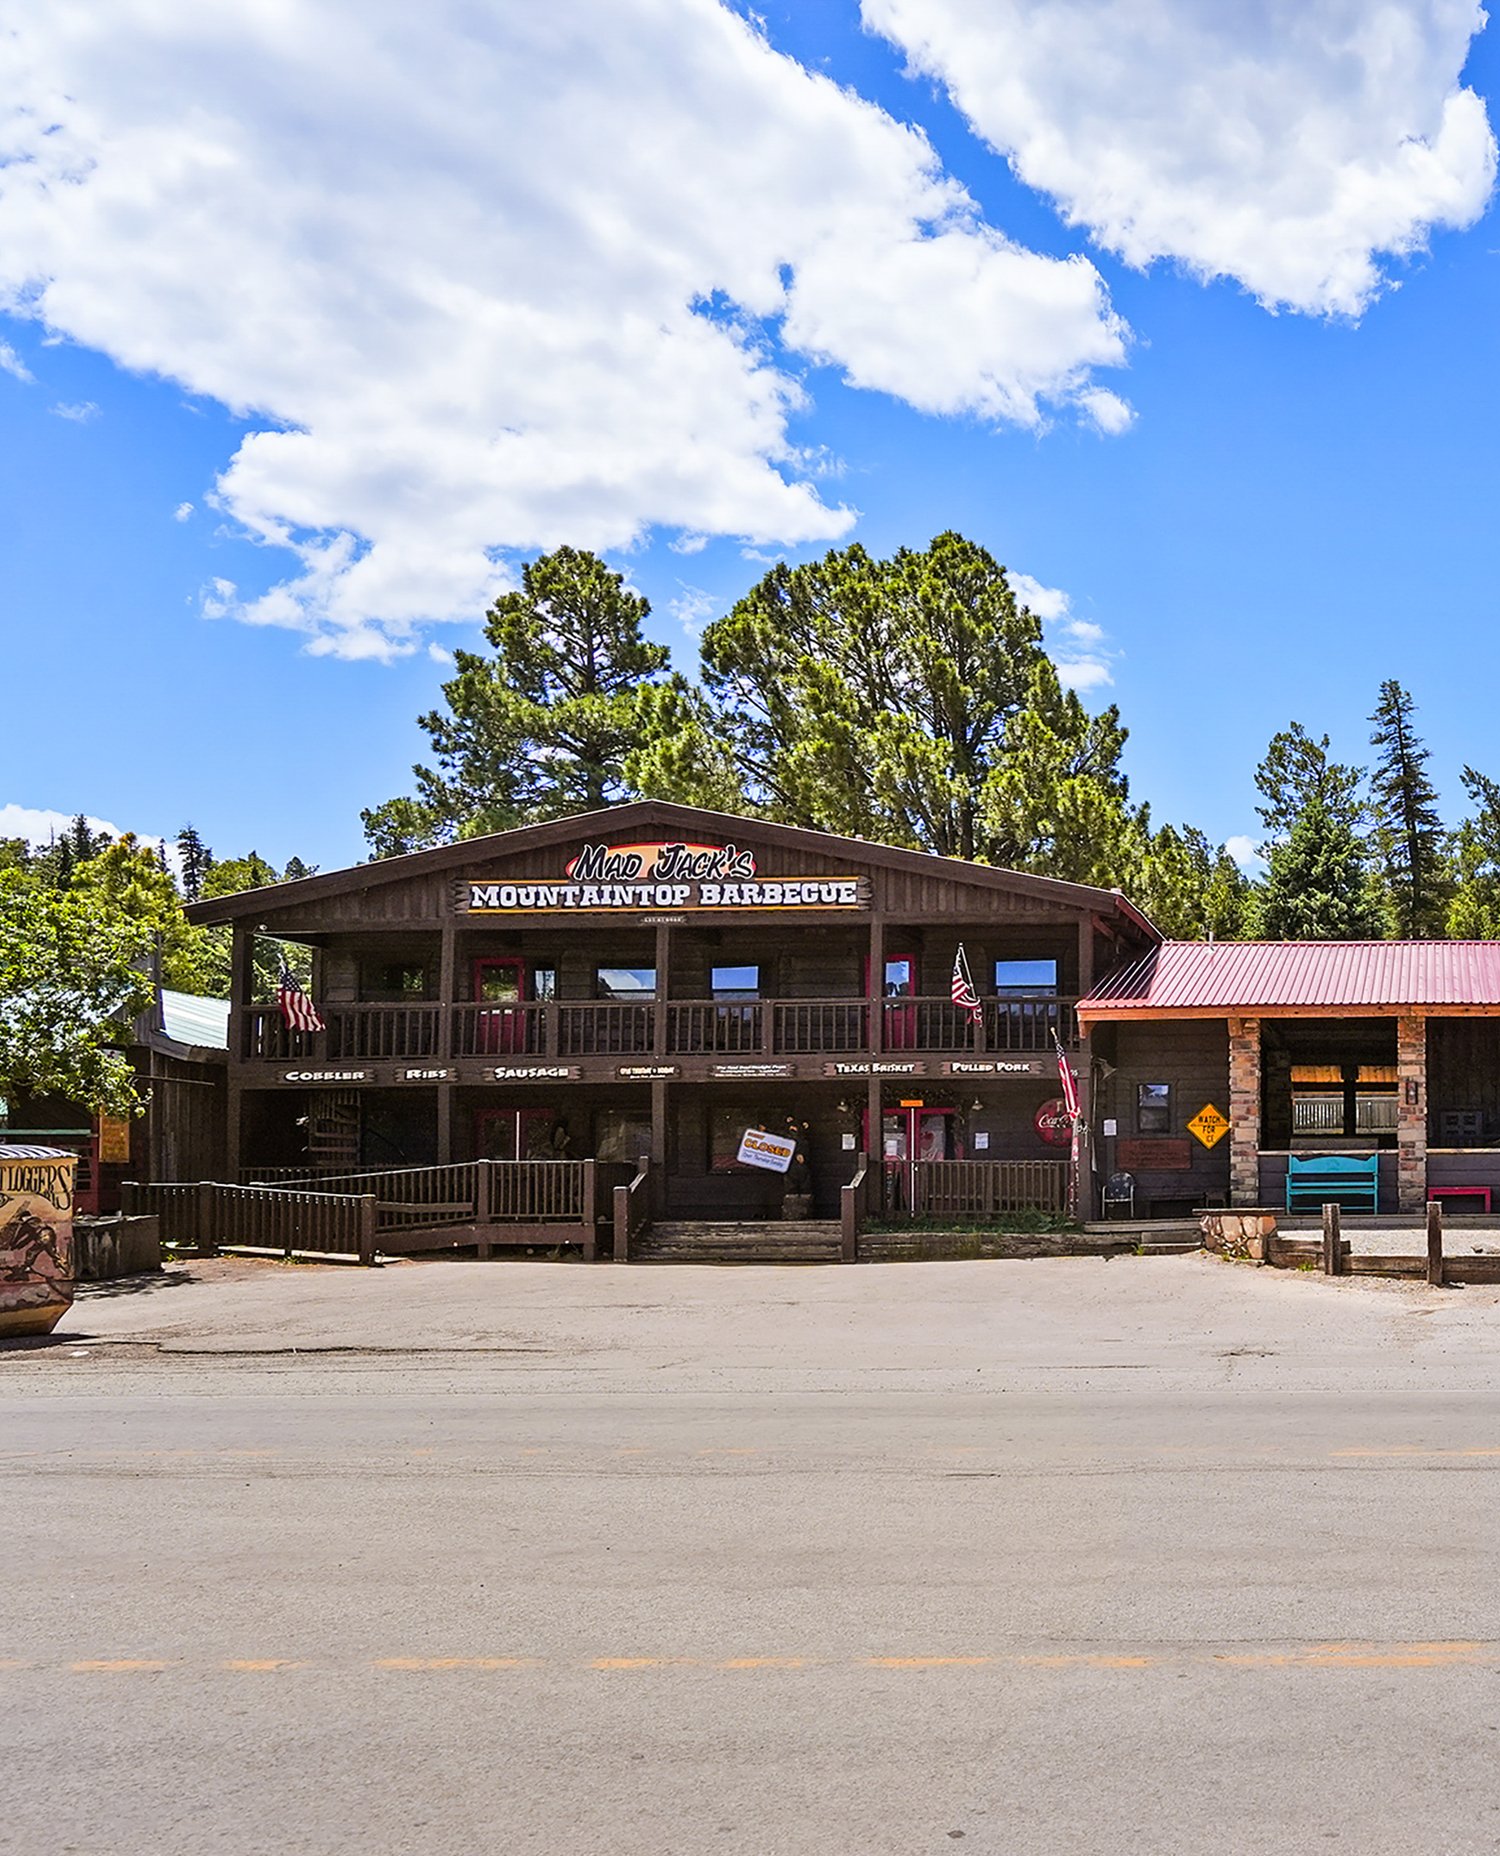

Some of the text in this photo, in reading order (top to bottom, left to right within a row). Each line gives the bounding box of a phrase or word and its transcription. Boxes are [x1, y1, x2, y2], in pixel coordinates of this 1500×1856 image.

[471, 881, 857, 908] MOUNTAINTOP BARBECUE
[285, 1071, 365, 1081] COBBLER
[494, 1067, 570, 1079] SAUSAGE
[1198, 1115, 1221, 1125] WATCH
[1202, 1125, 1216, 1134] FOR
[743, 1137, 791, 1158] CLOSED
[7, 1164, 72, 1211] LOGGERS
